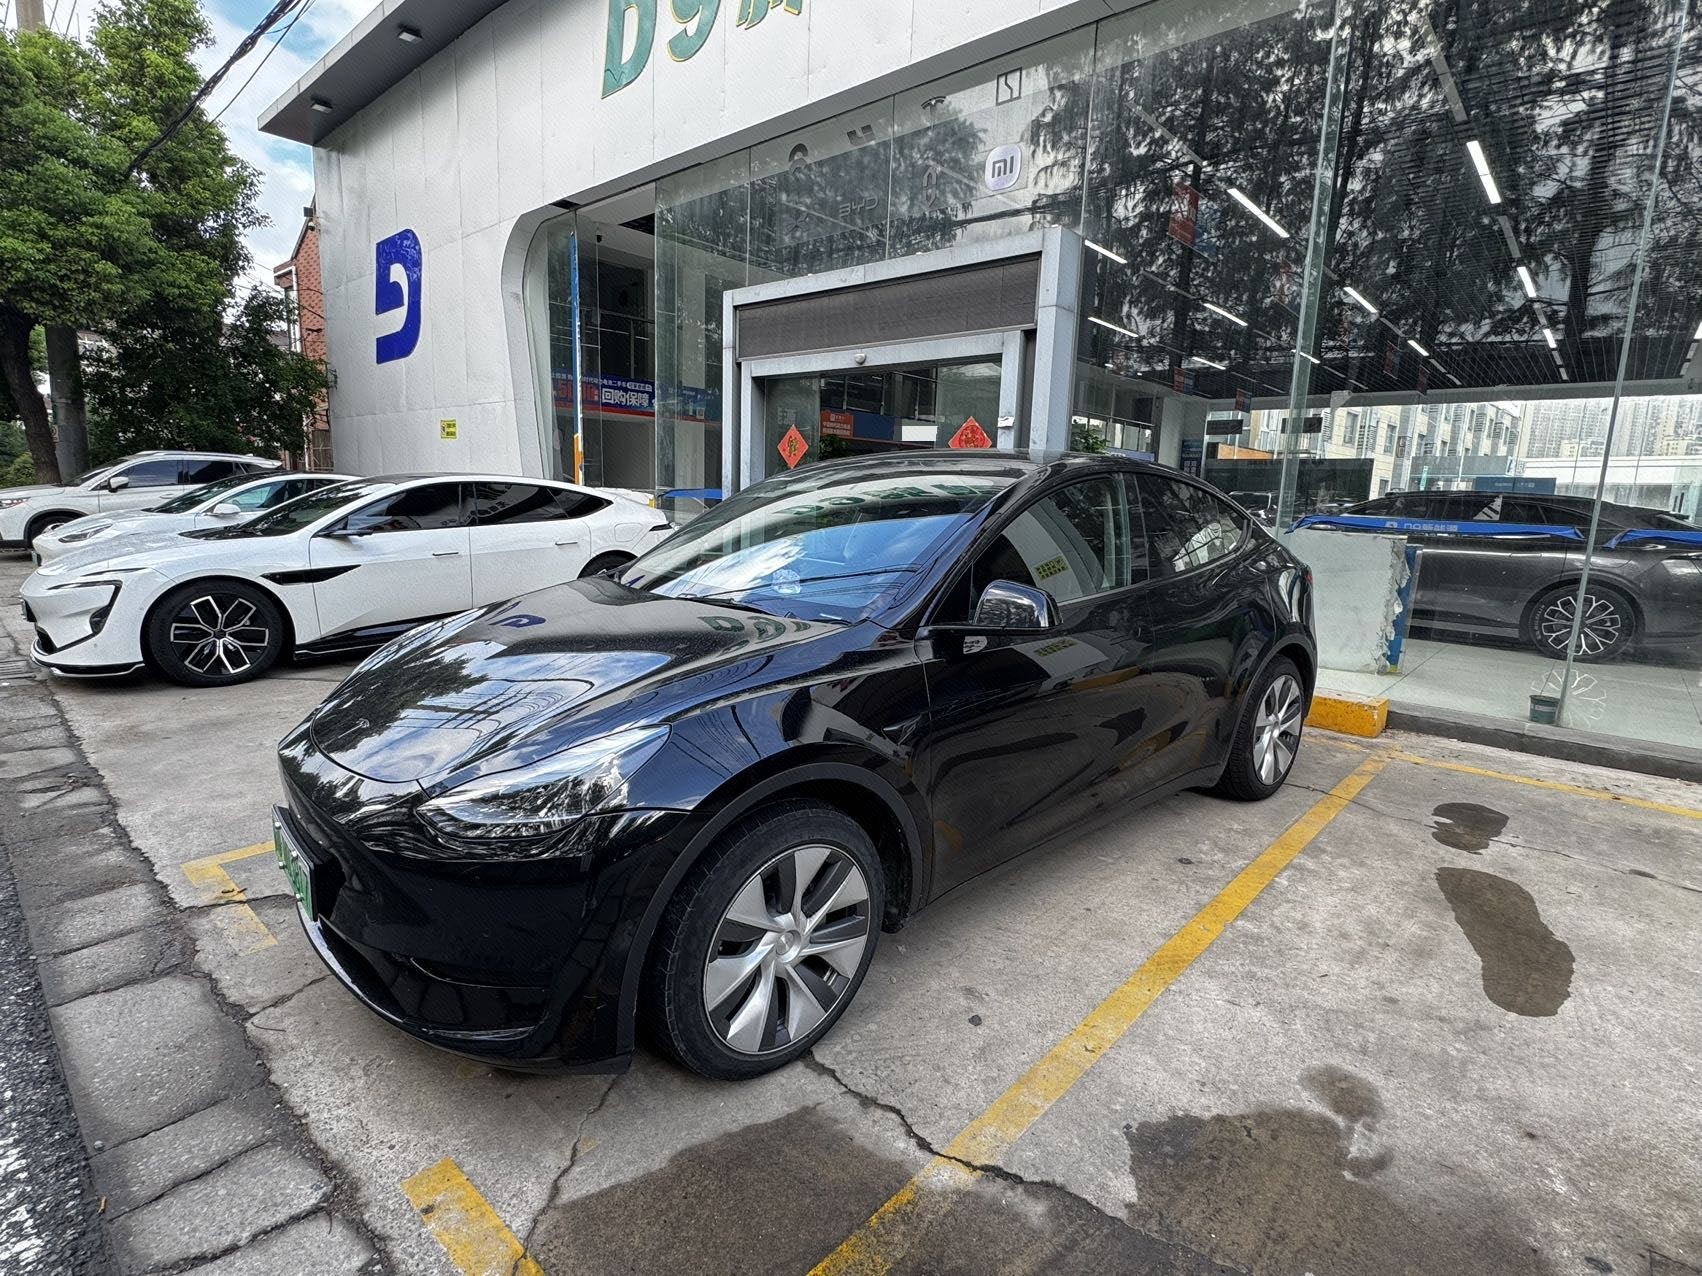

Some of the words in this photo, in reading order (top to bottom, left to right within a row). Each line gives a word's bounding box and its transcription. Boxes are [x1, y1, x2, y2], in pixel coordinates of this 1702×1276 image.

[839, 196, 878, 218] BYD
[602, 388, 649, 407] 回购保障
